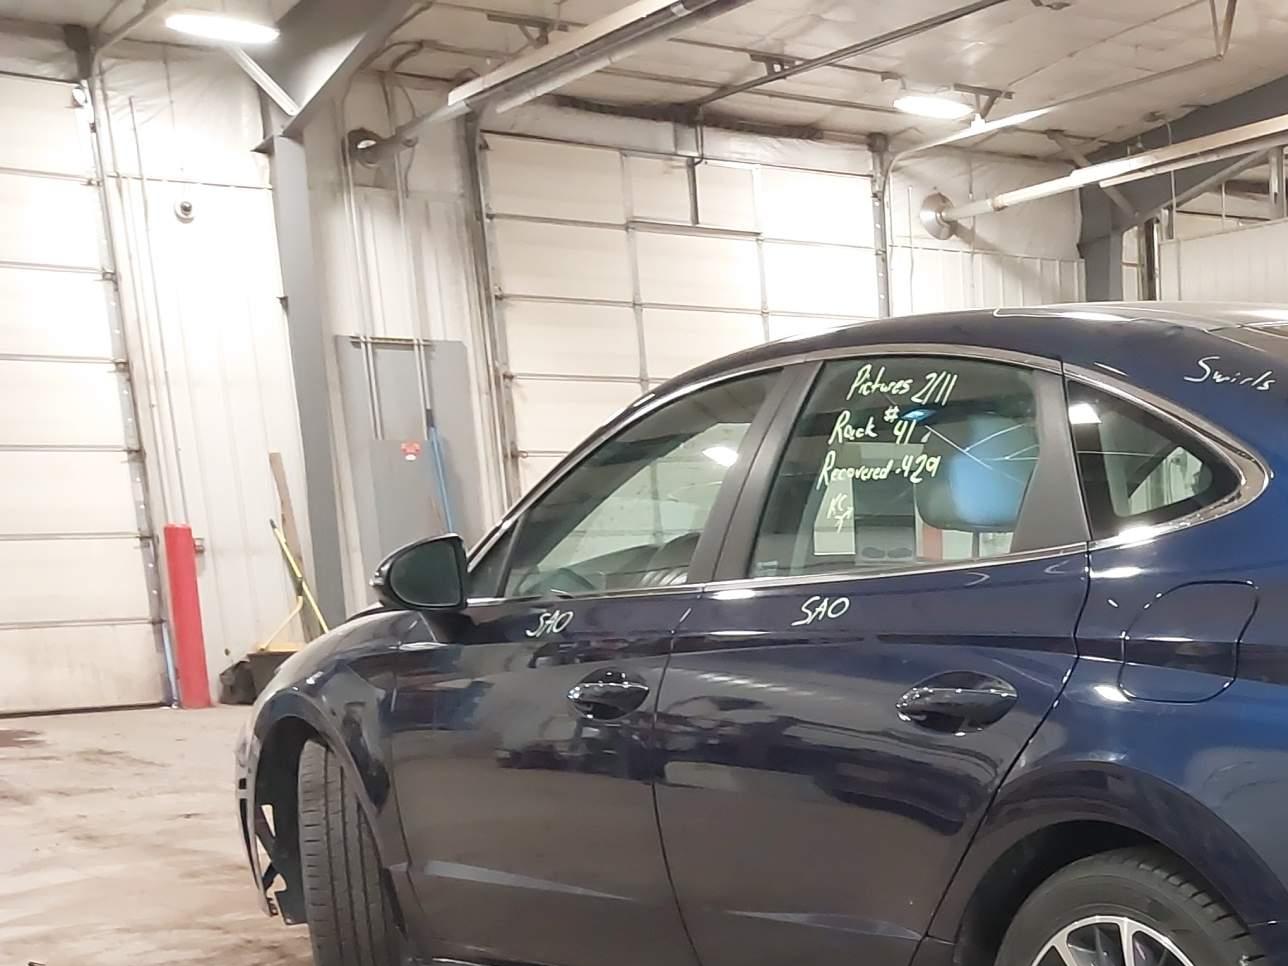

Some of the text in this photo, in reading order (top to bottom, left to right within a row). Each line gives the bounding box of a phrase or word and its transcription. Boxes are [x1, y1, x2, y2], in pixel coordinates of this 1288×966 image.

[846, 363, 958, 406] Pictures 2/11
[1183, 355, 1276, 391] Swirls
[828, 410, 878, 445] Rack
[816, 450, 894, 490] Recovered
